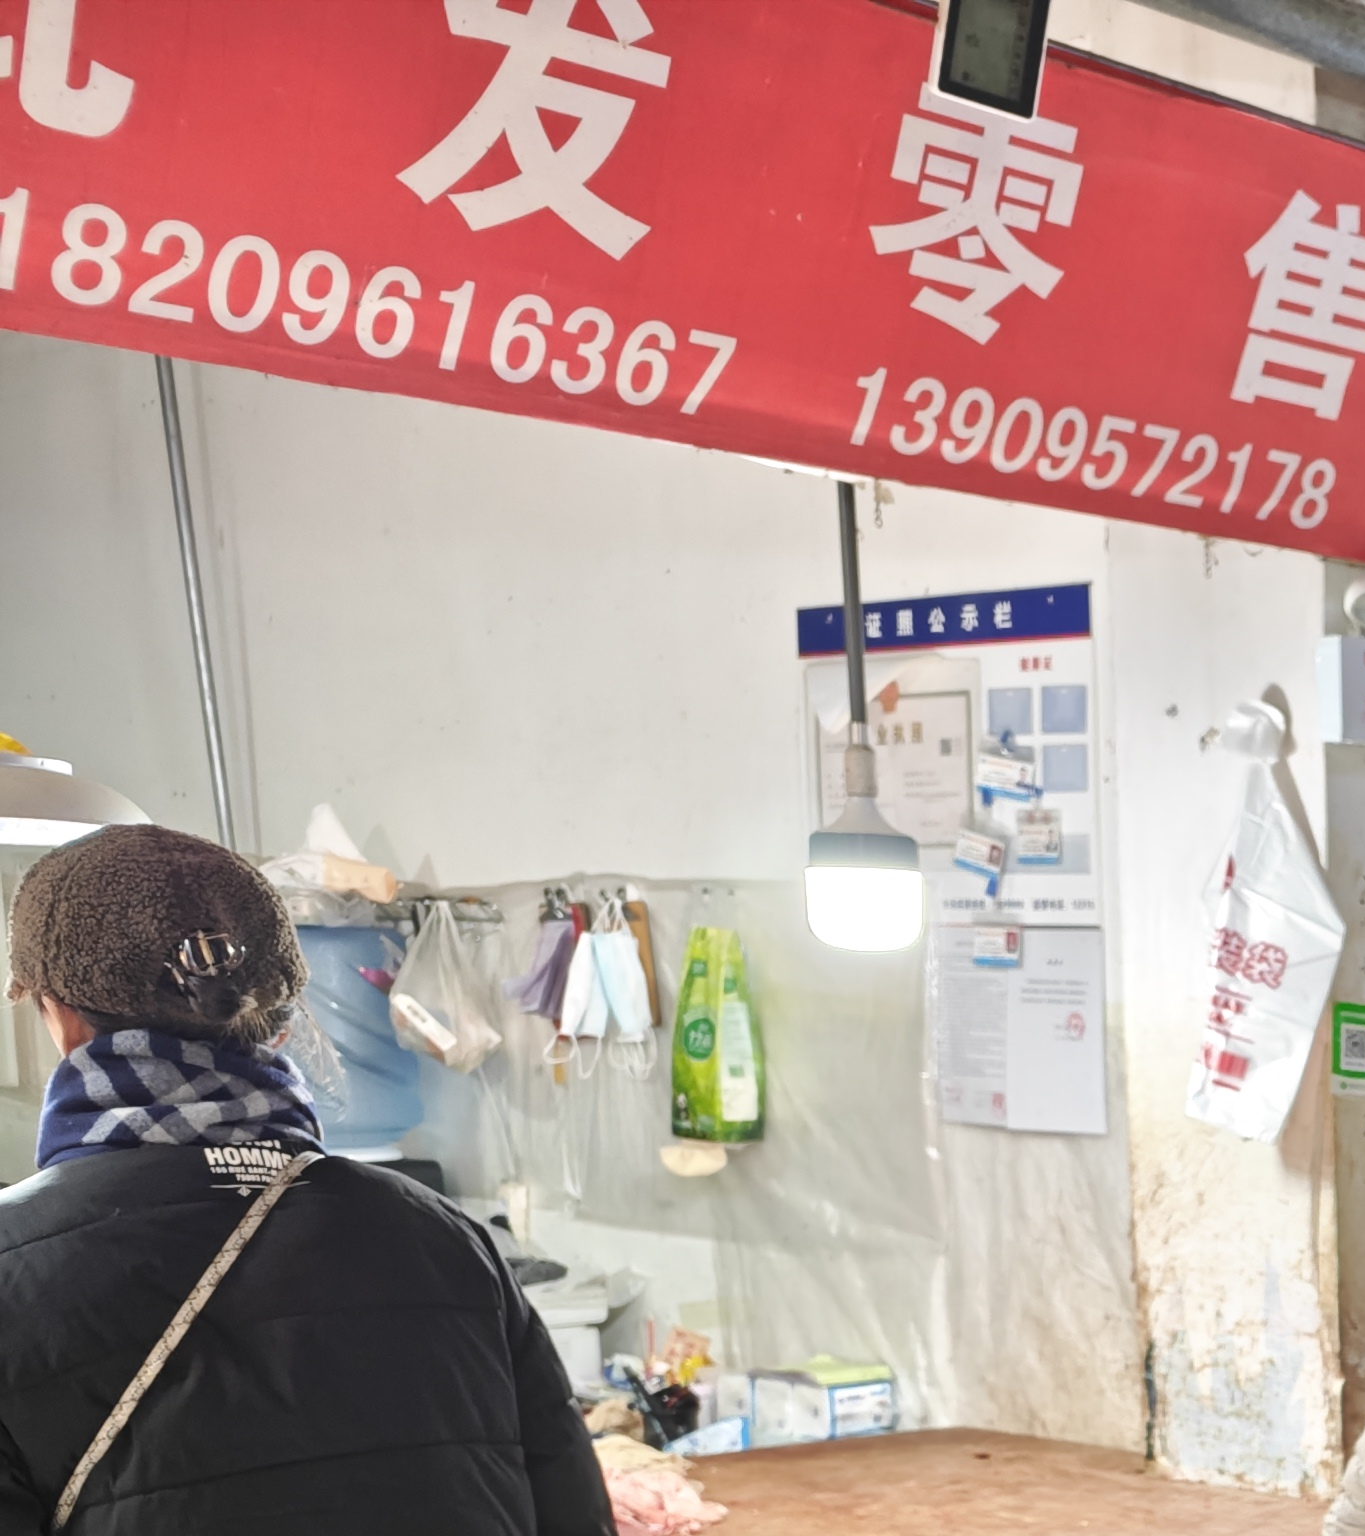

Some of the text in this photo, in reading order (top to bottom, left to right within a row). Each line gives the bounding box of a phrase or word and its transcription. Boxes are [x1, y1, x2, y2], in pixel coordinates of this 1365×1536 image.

[0, 187, 1337, 530] 18209616367 13909572178
[864, 600, 1013, 639] 证照公示栏
